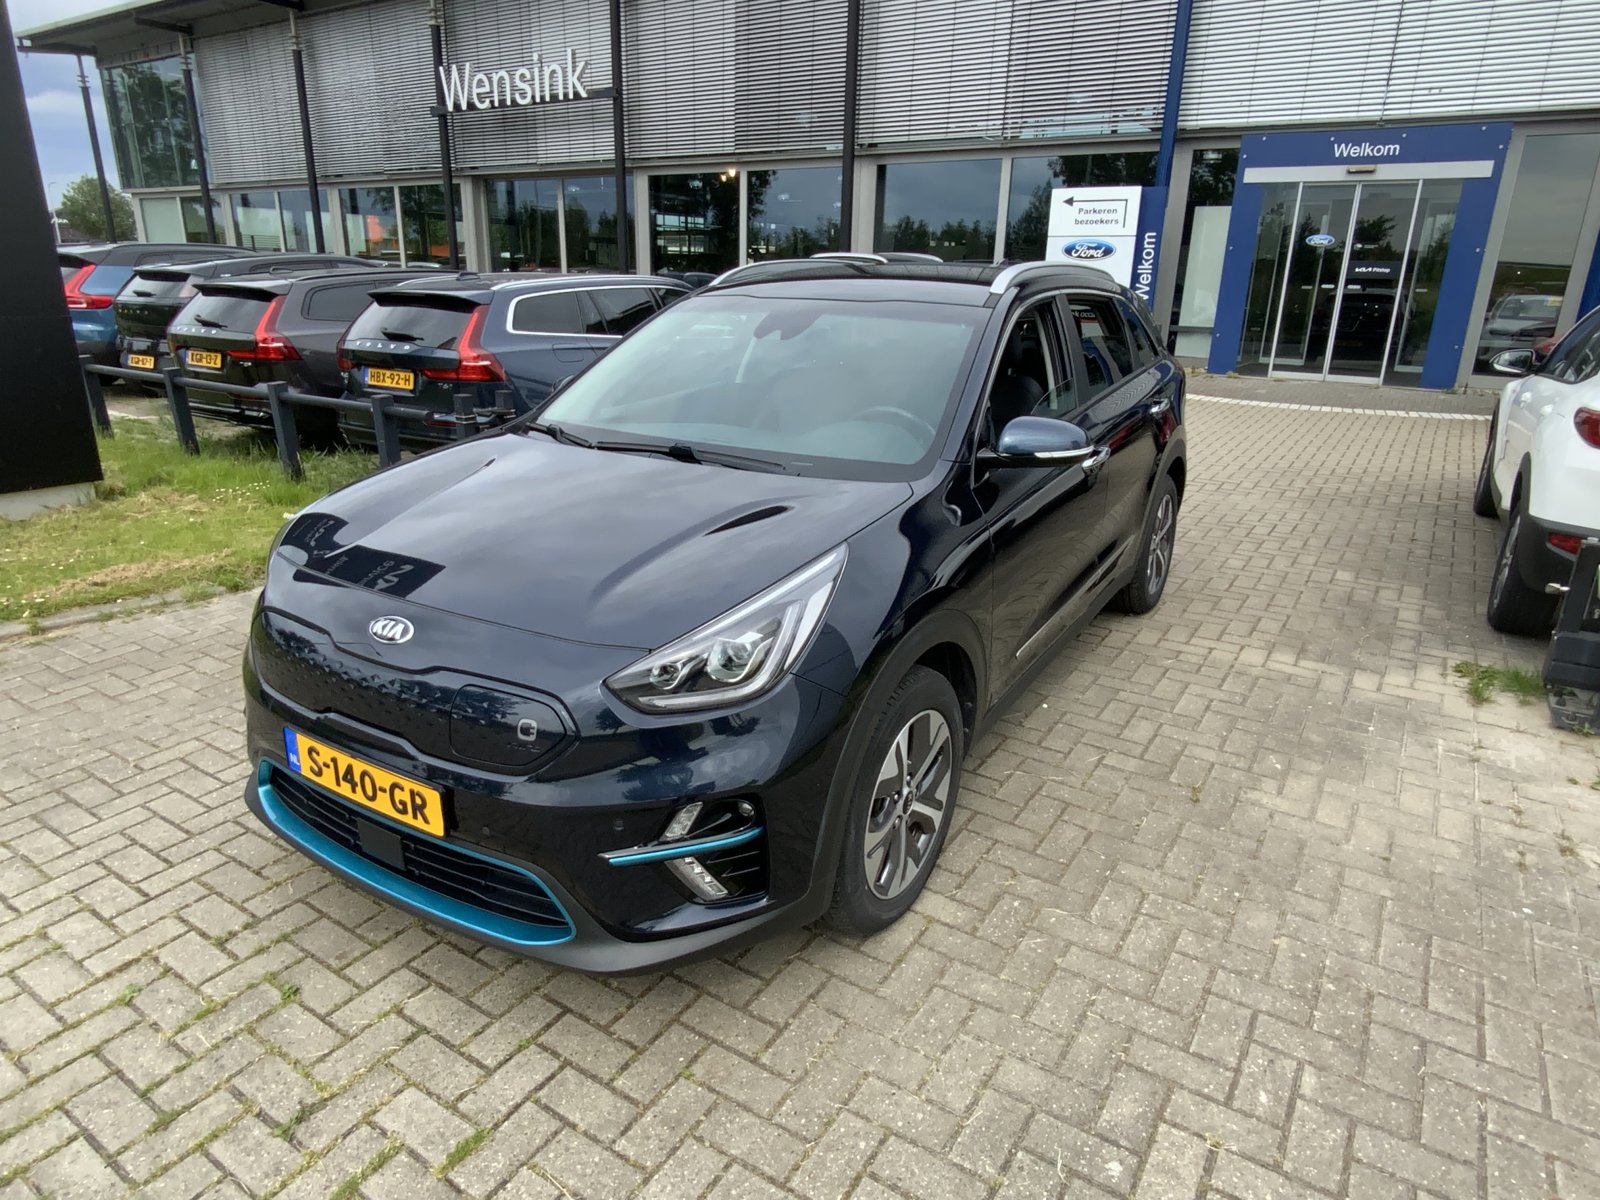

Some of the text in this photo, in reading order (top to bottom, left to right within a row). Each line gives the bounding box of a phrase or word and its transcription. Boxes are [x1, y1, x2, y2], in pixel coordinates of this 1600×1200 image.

[438, 48, 588, 112] Wensink
[1334, 142, 1400, 158] Welkom
[1078, 207, 1118, 215] Parkeren
[1135, 232, 1157, 300] Welkom
[370, 371, 411, 387] HBX-92-H
[372, 618, 406, 640] KIA
[289, 746, 430, 825] NL S-140-GR
